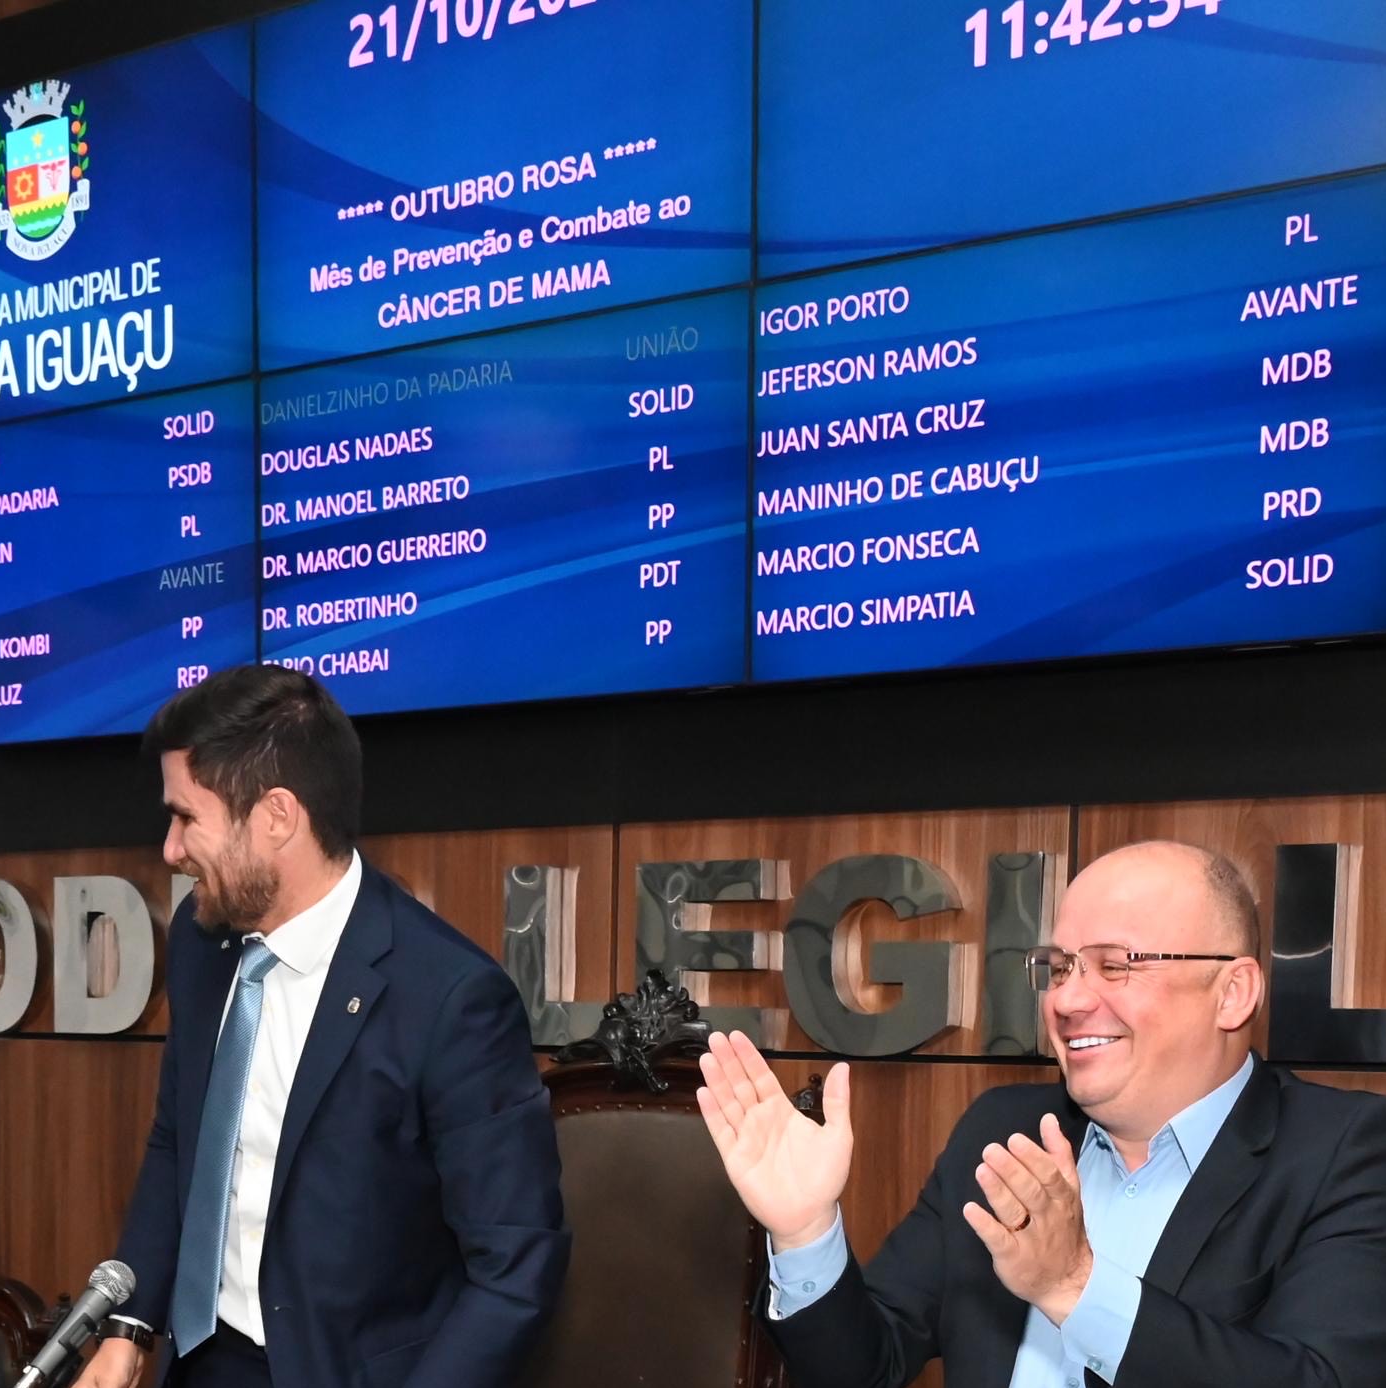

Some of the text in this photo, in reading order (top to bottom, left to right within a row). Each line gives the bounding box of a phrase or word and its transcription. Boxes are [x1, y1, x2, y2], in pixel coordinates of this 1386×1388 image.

[391, 151, 596, 222] OUTUBRO ROSA
[310, 193, 691, 293] Mês de Prevenção e Combate ao
[1285, 213, 1319, 247] PL
[15, 267, 128, 323] MUNICIPAL
[131, 257, 161, 297] DE
[377, 259, 611, 329] CÂNCER DE MAMA
[1241, 275, 1359, 323] AVANTE
[760, 285, 909, 337] IGOR PORTO
[26, 304, 173, 393] IGUAÇU
[626, 327, 699, 362] UNIÃO
[758, 337, 977, 397] JEFERSON RAMOS
[1262, 349, 1332, 387] MDB
[261, 360, 513, 425] DANIELZINHO DA PADARIA
[628, 383, 694, 418] SOLID
[163, 410, 214, 439] SOLID
[757, 399, 985, 458] JUAN SANTA CRUZ
[1259, 418, 1330, 456] MDB
[261, 426, 433, 476] DOUGLAS NADAES
[649, 446, 674, 472] PL
[168, 462, 212, 489] PSDB
[758, 455, 1040, 518] MANINHO DE CABUÇU
[261, 475, 469, 527] DR. MANOEL BARRETO
[648, 503, 675, 530] PP
[1263, 486, 1322, 522] PRD
[181, 515, 201, 537] PL
[262, 527, 487, 579] DR. MARCIO GUERREIRO
[758, 527, 980, 578] MARCIO FONSECA
[159, 562, 224, 590] AVANTE
[639, 559, 681, 589] PDT
[1245, 553, 1334, 591] SOLID
[182, 616, 203, 639] PP
[262, 591, 418, 631] DR. ROBERTINHO
[757, 589, 975, 637] MARCIO SIMPATIA
[0, 634, 50, 658] KOMBI
[645, 619, 672, 646] PP
[319, 648, 389, 677] CHABAI
